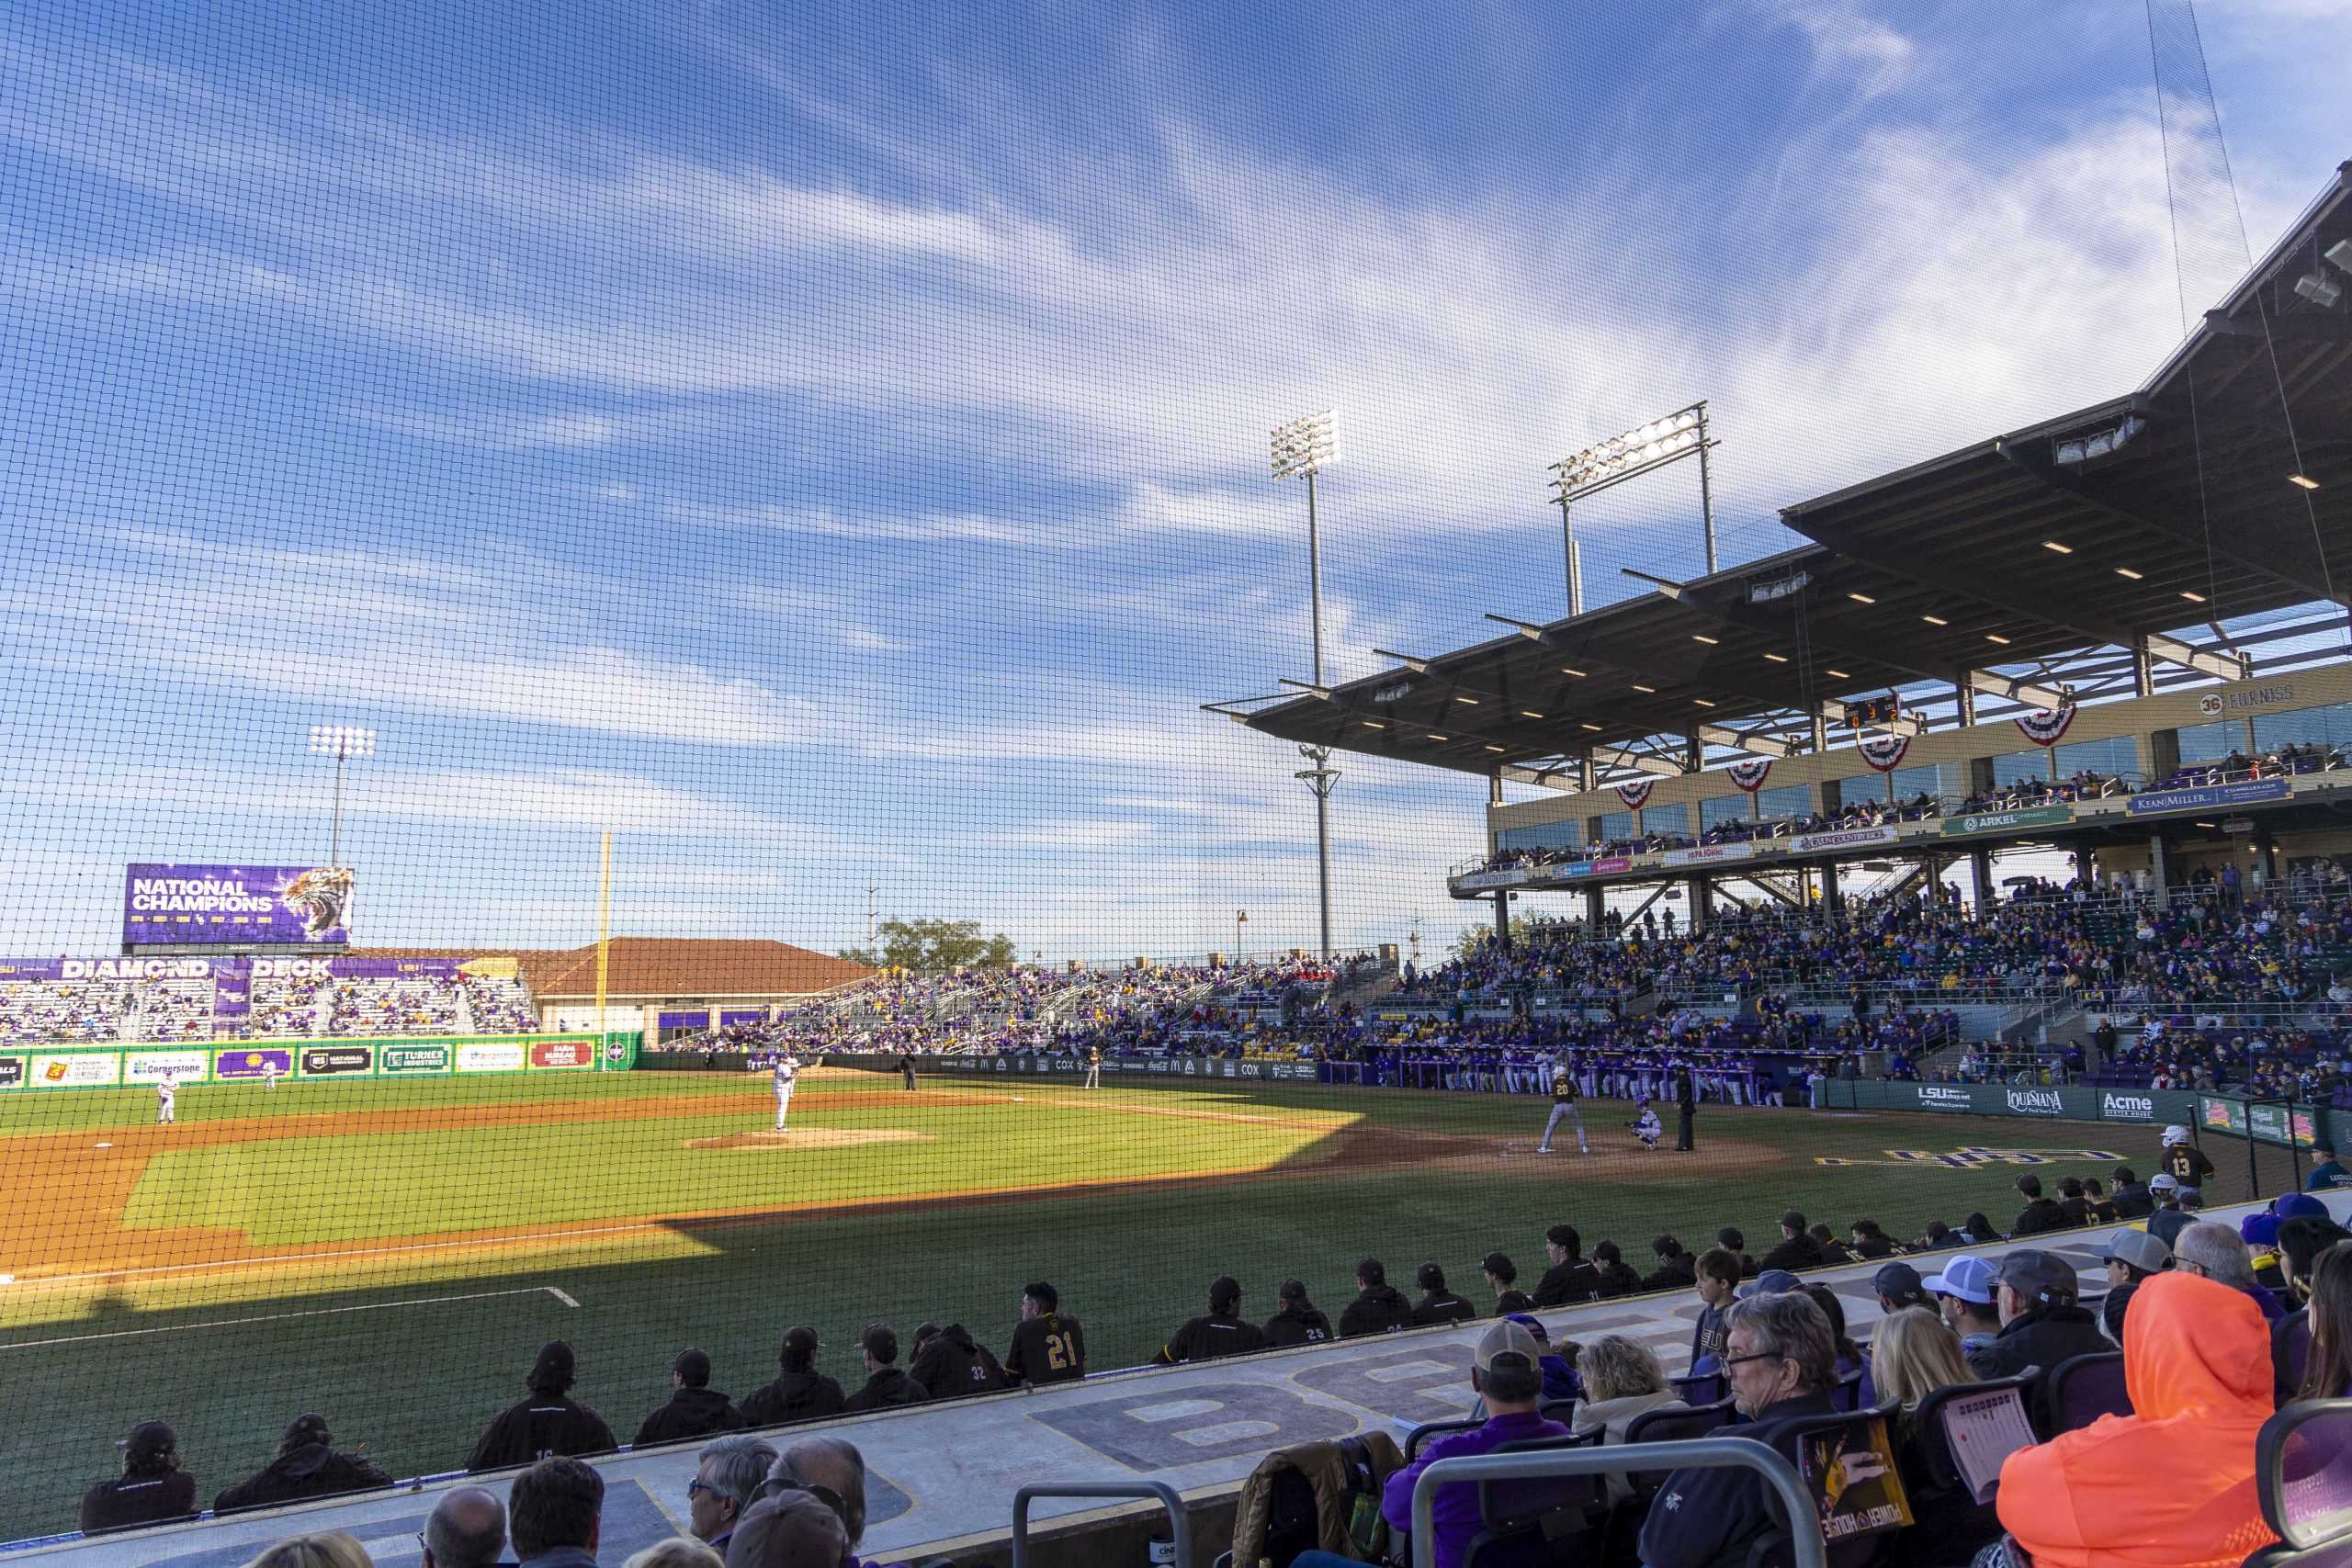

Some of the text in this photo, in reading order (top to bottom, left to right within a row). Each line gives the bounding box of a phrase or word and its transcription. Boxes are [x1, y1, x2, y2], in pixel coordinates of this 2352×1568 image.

[2201, 686, 2294, 712] 36 FURNISS
[1979, 815, 2018, 828] ARKEL
[133, 879, 249, 896] NATIONAL
[132, 895, 273, 911] CHAMPIONS
[62, 959, 334, 978] DIAMOND DECK
[404, 1051, 443, 1060] TURNER
[147, 1064, 200, 1075] Cornerstone
[1056, 1060, 1074, 1071] COX
[1241, 1064, 1259, 1076] COX
[1917, 1088, 1948, 1099] LSU
[2007, 1089, 2064, 1112] LOUISIANA
[2103, 1092, 2153, 1111] Acme
[2172, 1157, 2191, 1177] 13
[1306, 1328, 1325, 1341] 25
[1045, 1331, 1077, 1371] 21
[971, 1366, 986, 1381] 32
[1822, 1503, 1903, 1538] POWER HOUSE
